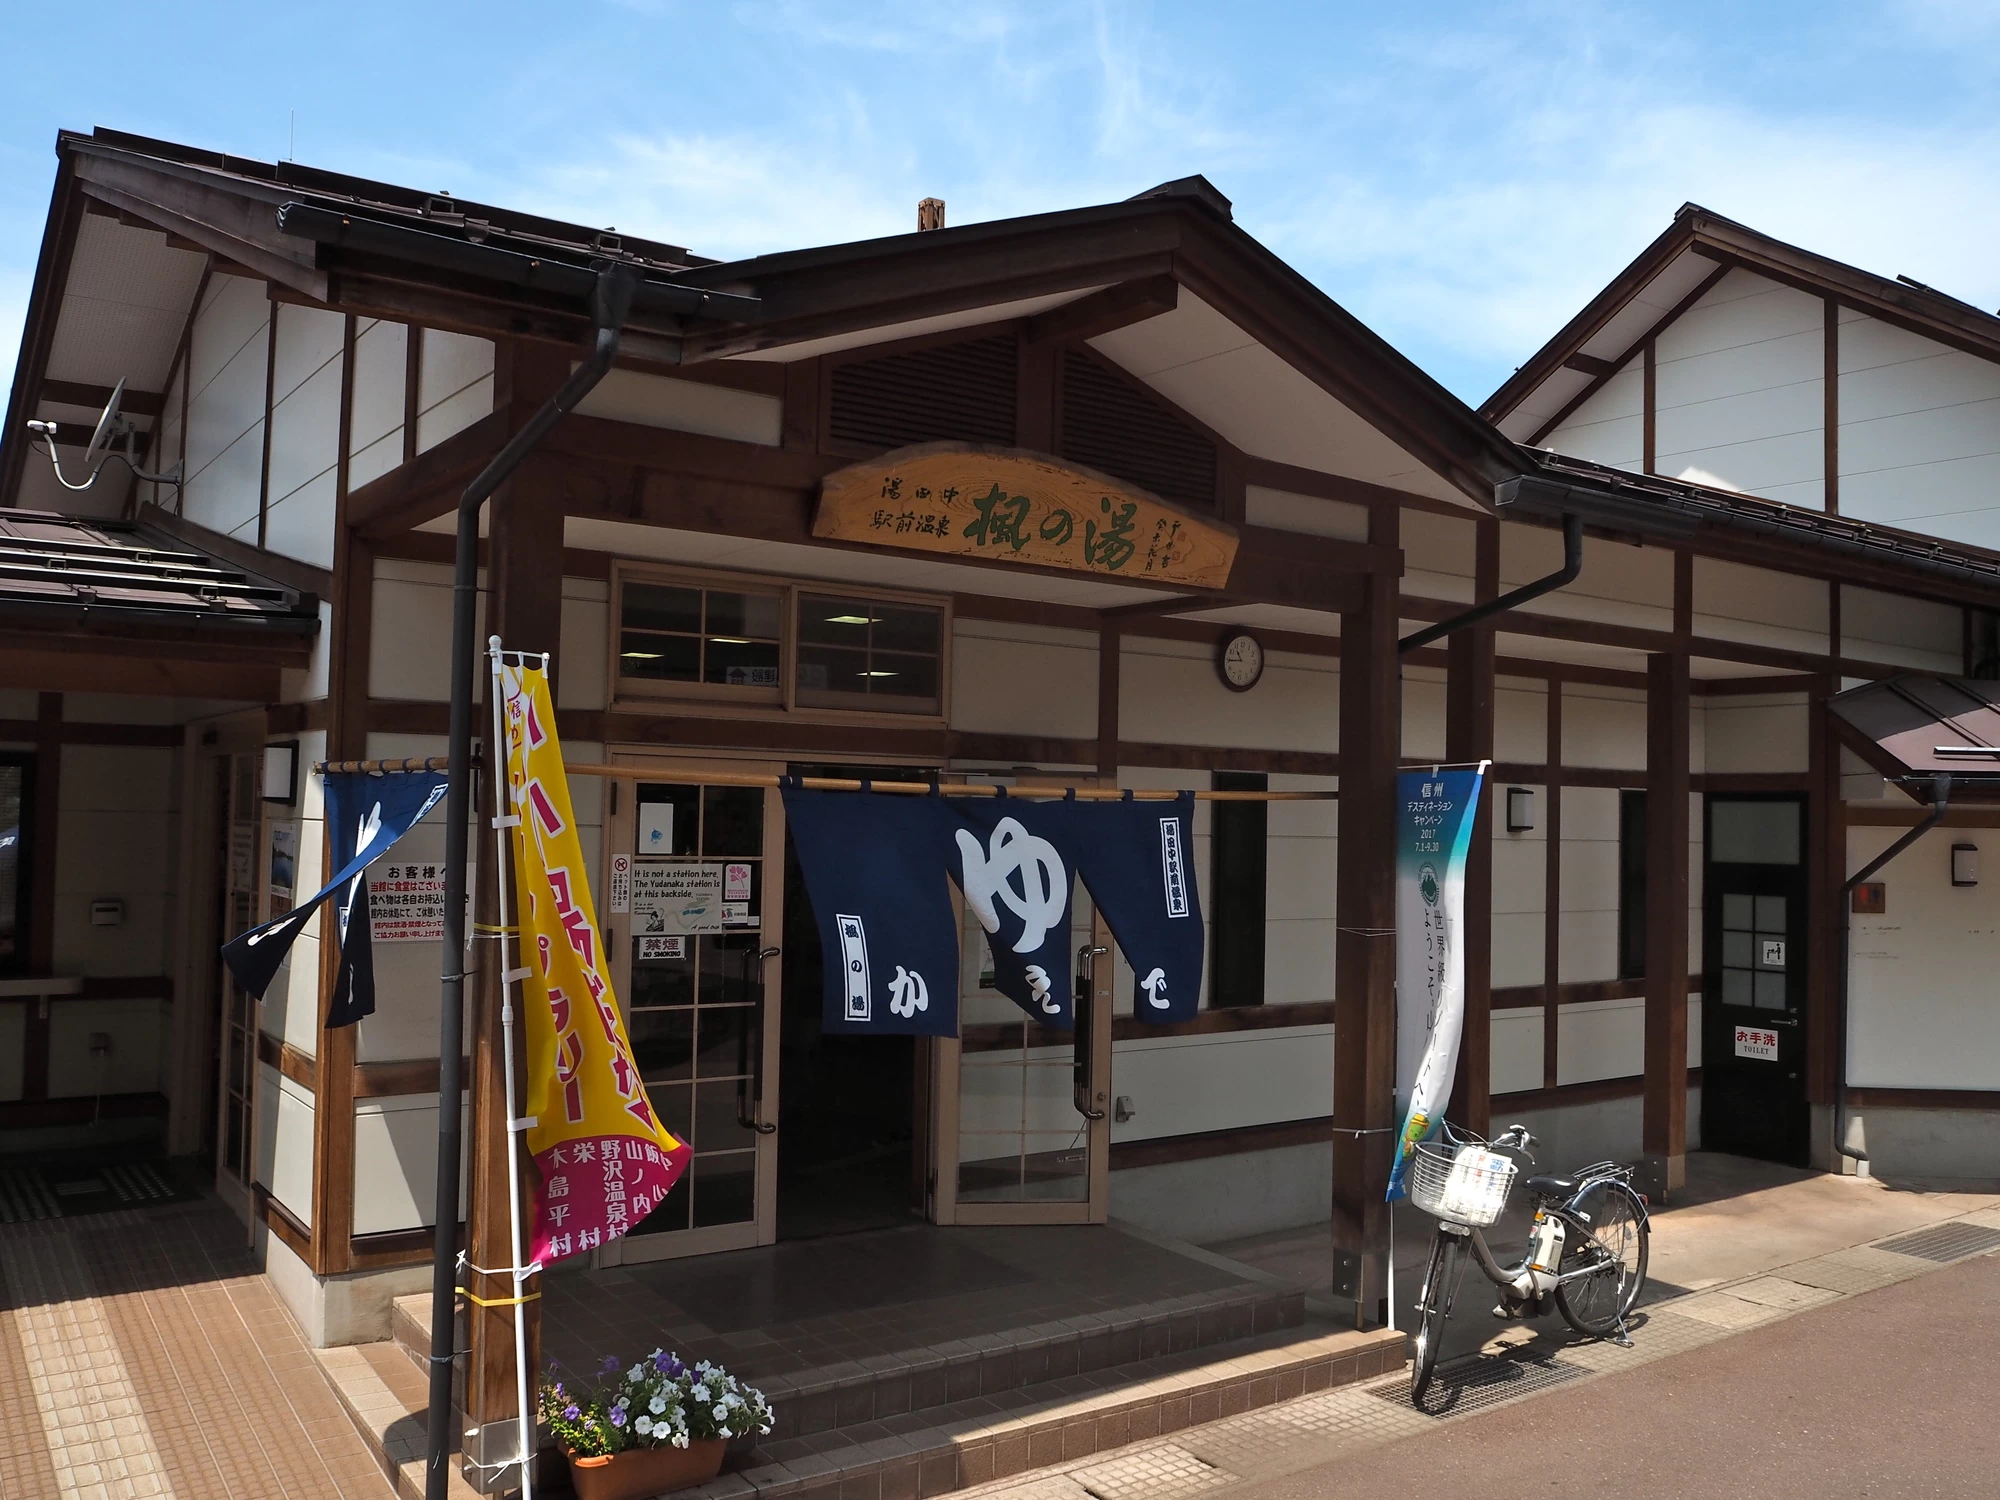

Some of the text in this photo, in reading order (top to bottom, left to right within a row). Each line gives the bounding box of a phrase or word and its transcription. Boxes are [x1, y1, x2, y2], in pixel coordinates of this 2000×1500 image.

[881, 477, 960, 504] 湯田中
[869, 509, 951, 538] 駅前温泉
[963, 483, 1137, 571] 楓の湯
[1421, 782, 1444, 798] 信州
[1407, 801, 1453, 812] デスティネーション
[1414, 815, 1443, 826] キャンペーン
[1420, 829, 1436, 839] 2017
[1415, 842, 1439, 852] 7.1-9.30
[634, 870, 641, 878] It
[643, 870, 650, 878] is
[651, 870, 664, 878] not
[673, 870, 700, 878] station
[1164, 823, 1183, 912] 湯田中駅前温泉
[634, 880, 720, 888] The Yudanaka station is
[954, 816, 1069, 954] ゆ
[634, 890, 642, 898] at
[644, 890, 659, 898] this
[374, 920, 445, 929] 館内は禁酒・禁煙となって
[645, 938, 679, 951] 禁煙
[844, 923, 866, 1012] 楓の湯
[887, 965, 929, 1018] か
[1141, 967, 1171, 1010] で
[1737, 1031, 1775, 1046] お手洗
[1744, 1046, 1769, 1055] TOILET
[626, 1140, 652, 1225] 山ノ内
[548, 1147, 572, 1257] 木島平村
